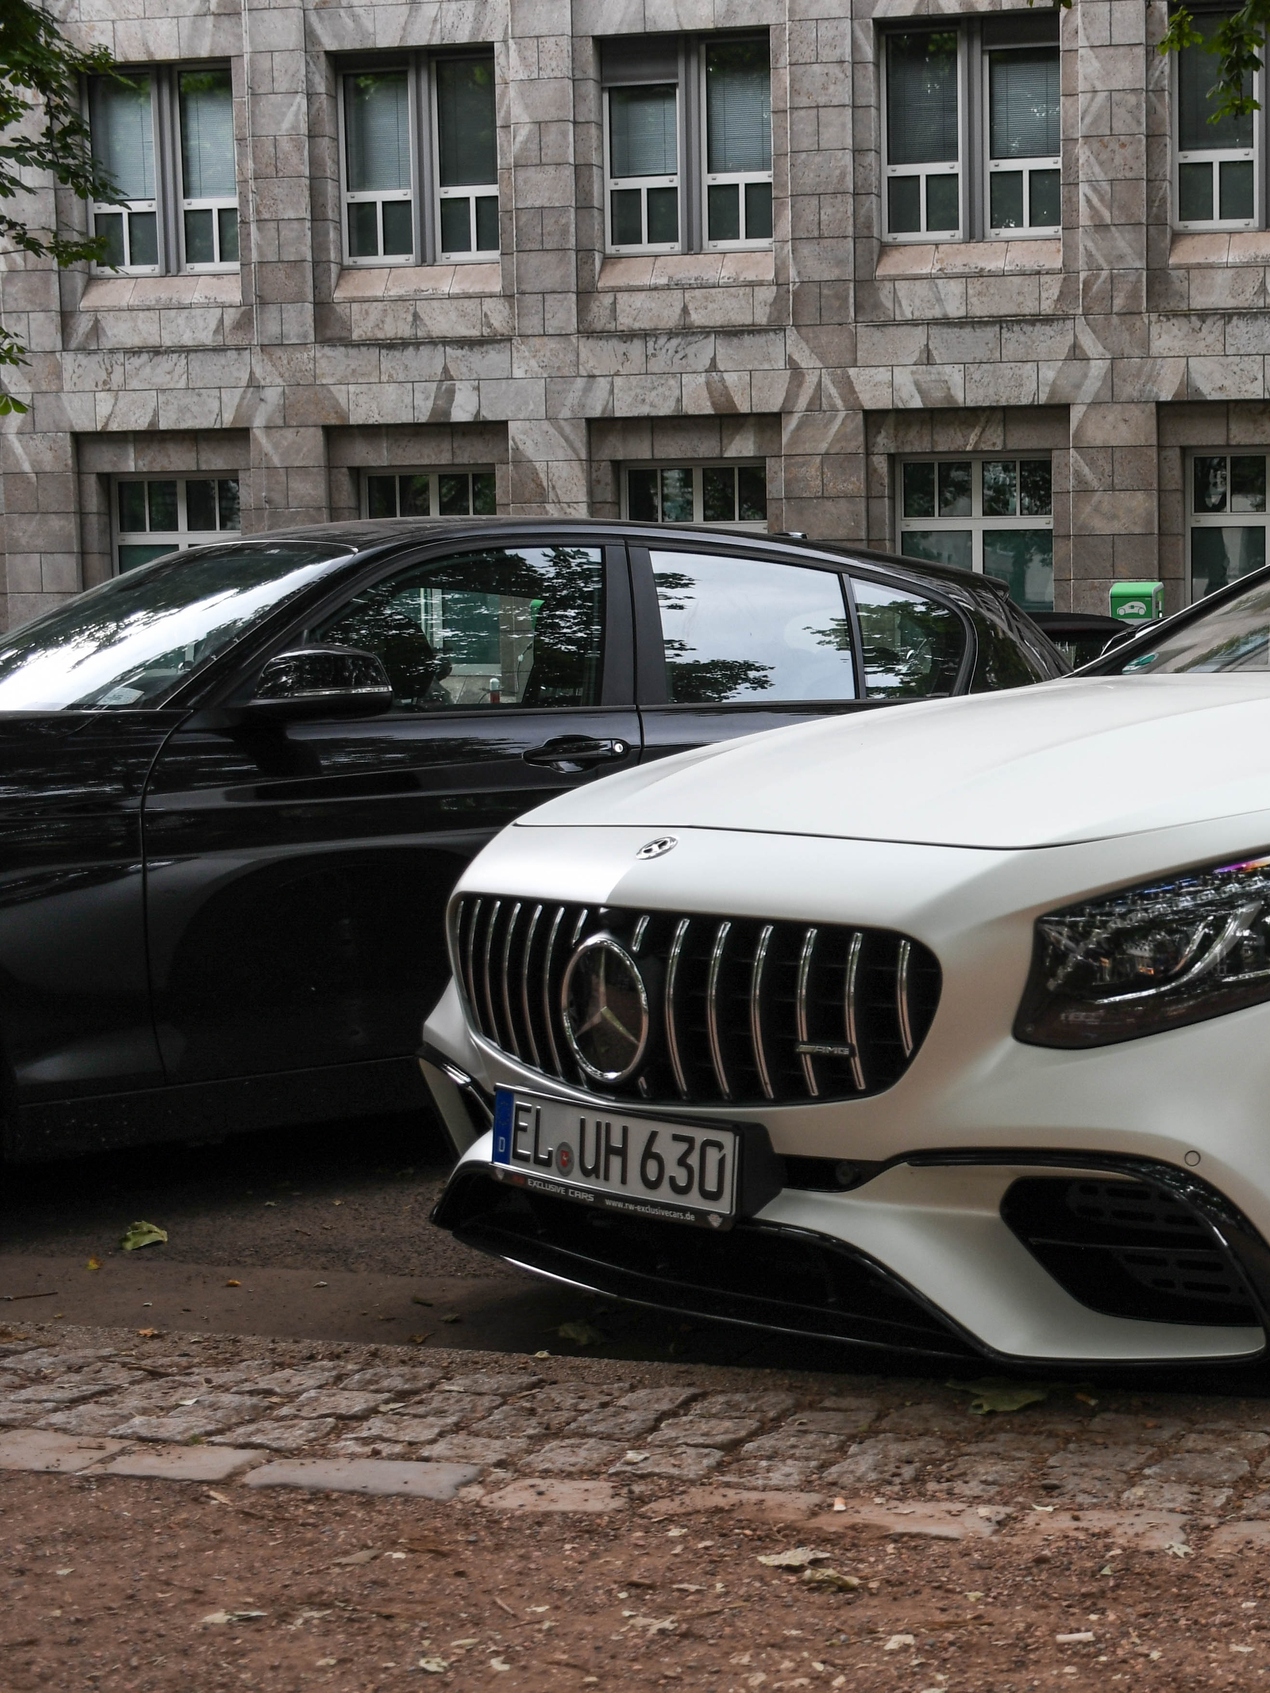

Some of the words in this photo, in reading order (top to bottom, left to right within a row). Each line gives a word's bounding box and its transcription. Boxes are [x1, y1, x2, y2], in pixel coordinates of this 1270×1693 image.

[814, 1045, 849, 1055] AMG
[498, 1136, 506, 1153] D
[512, 1101, 553, 1168] EL
[579, 1115, 629, 1185] UH
[639, 1130, 727, 1202] 630
[527, 1179, 566, 1195] EXCLUSIVE
[568, 1188, 595, 1202] CARS
[605, 1198, 696, 1222] www.rw-exclusivecars.de
